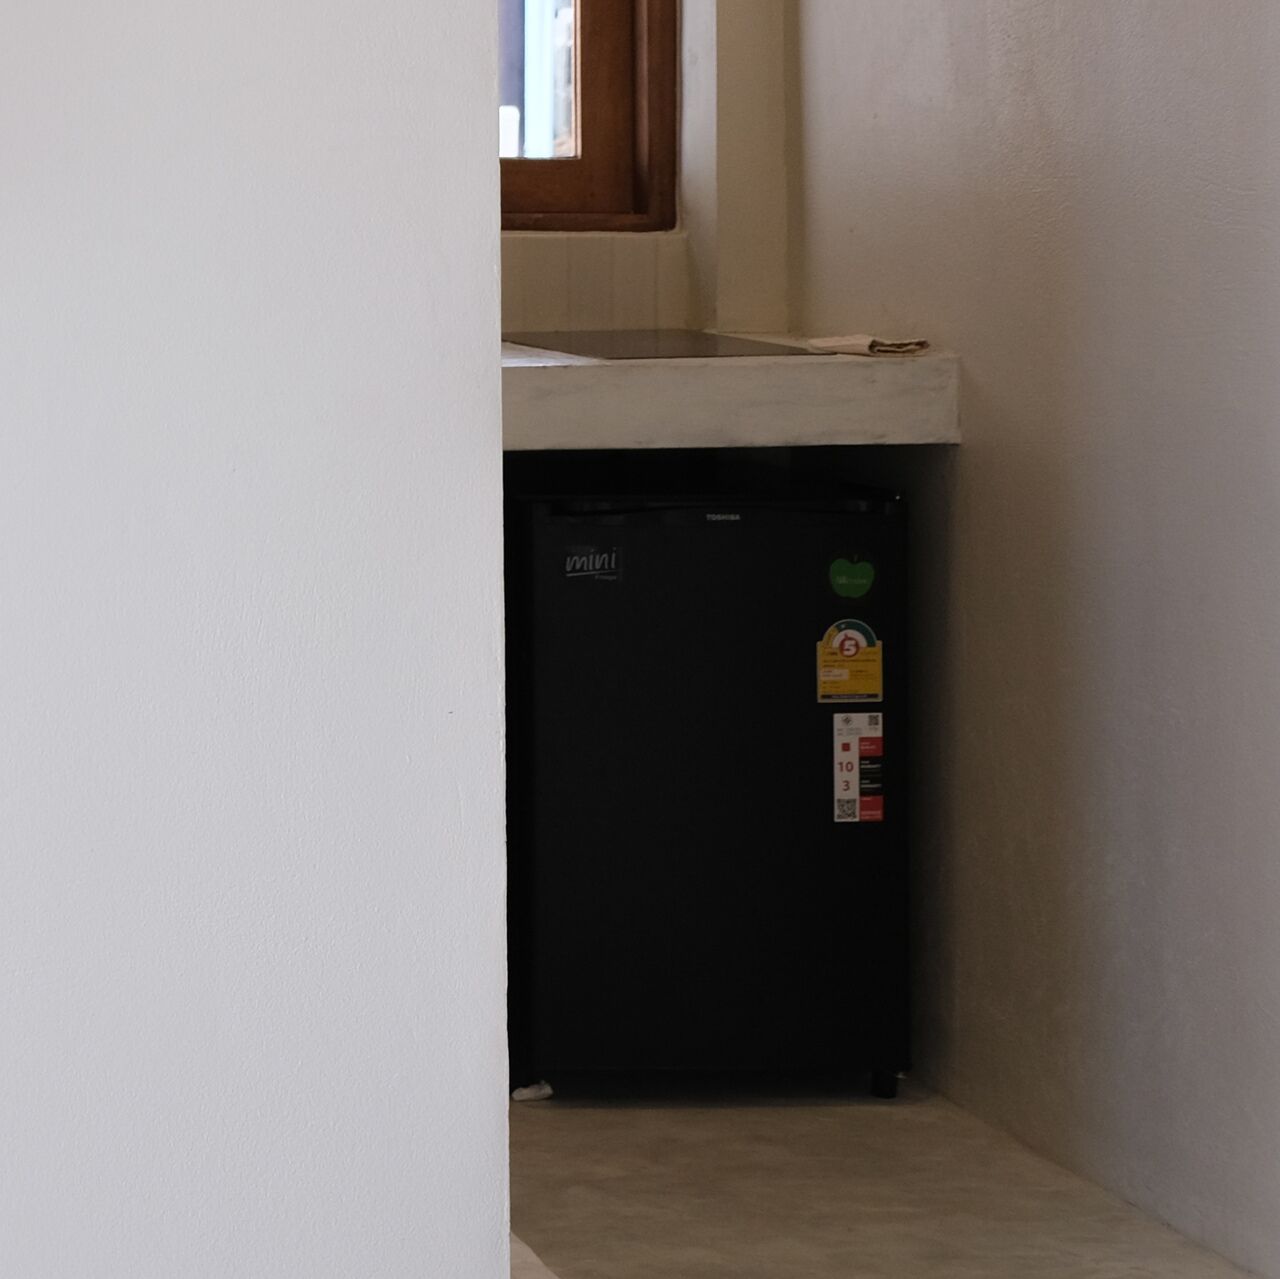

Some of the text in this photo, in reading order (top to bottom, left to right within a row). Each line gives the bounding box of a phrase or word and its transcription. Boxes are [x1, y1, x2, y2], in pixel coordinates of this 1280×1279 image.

[565, 547, 617, 572] mini
[843, 640, 857, 656] 5
[838, 761, 854, 772] 10
[842, 780, 850, 791] 3
